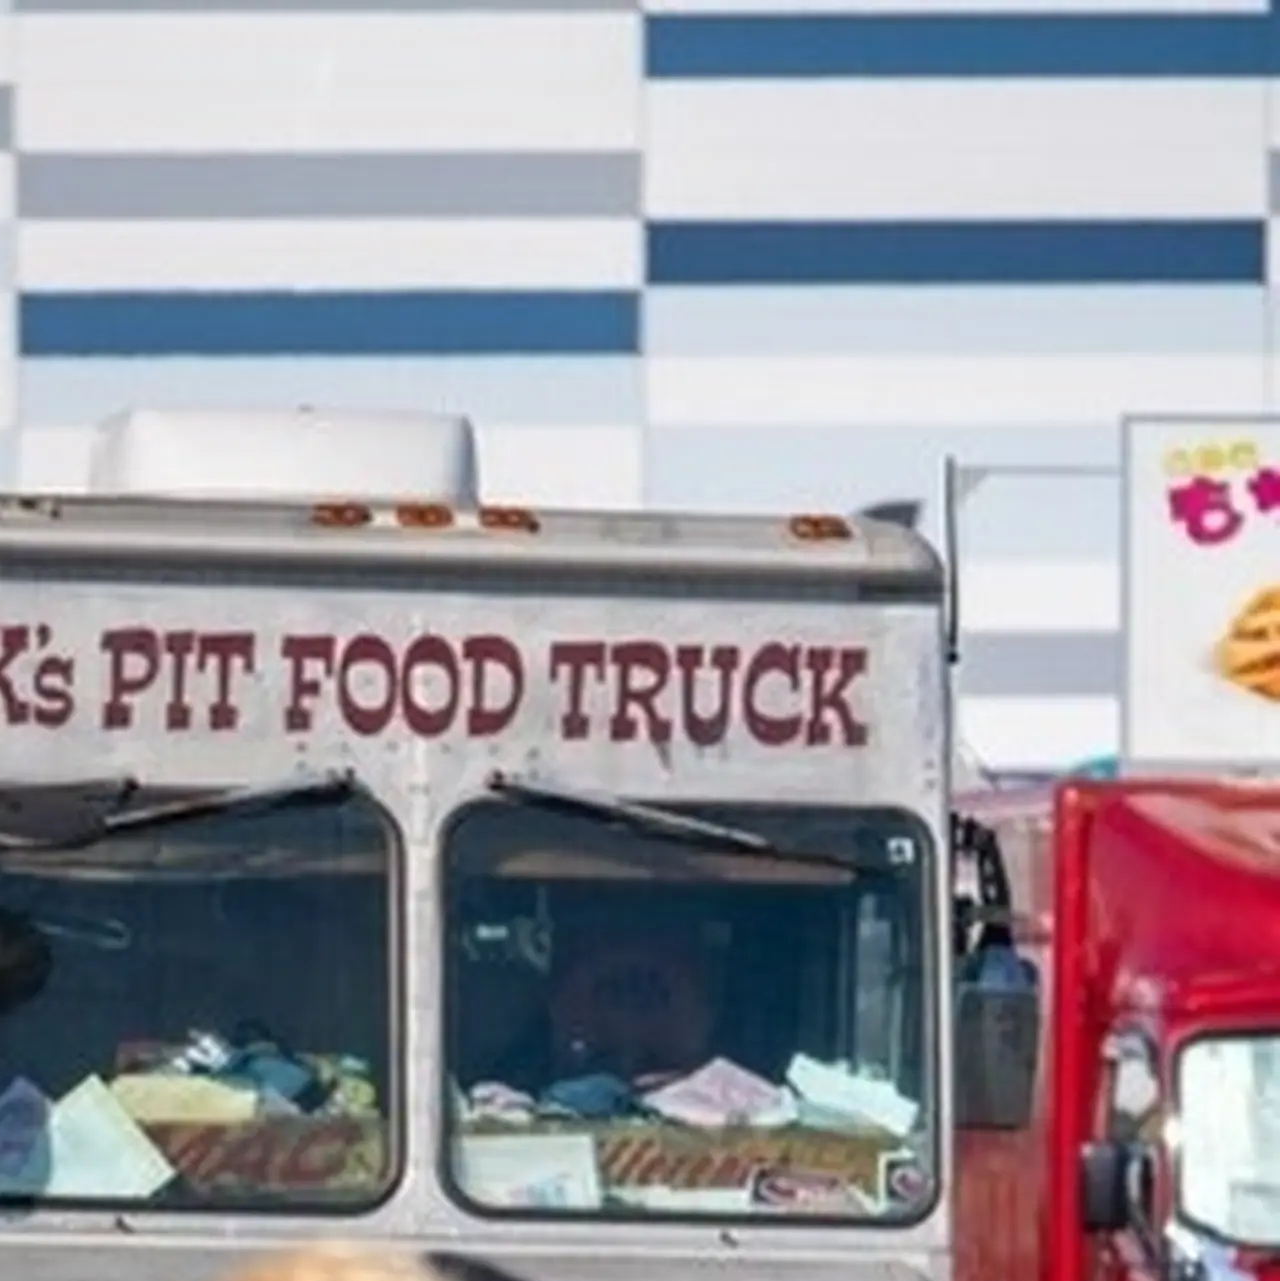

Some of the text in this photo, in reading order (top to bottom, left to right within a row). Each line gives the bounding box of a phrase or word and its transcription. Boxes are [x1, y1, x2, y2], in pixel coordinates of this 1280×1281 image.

[100, 627, 255, 732] PIT
[281, 634, 525, 738] FOOD
[549, 640, 870, 748] TRUCK
